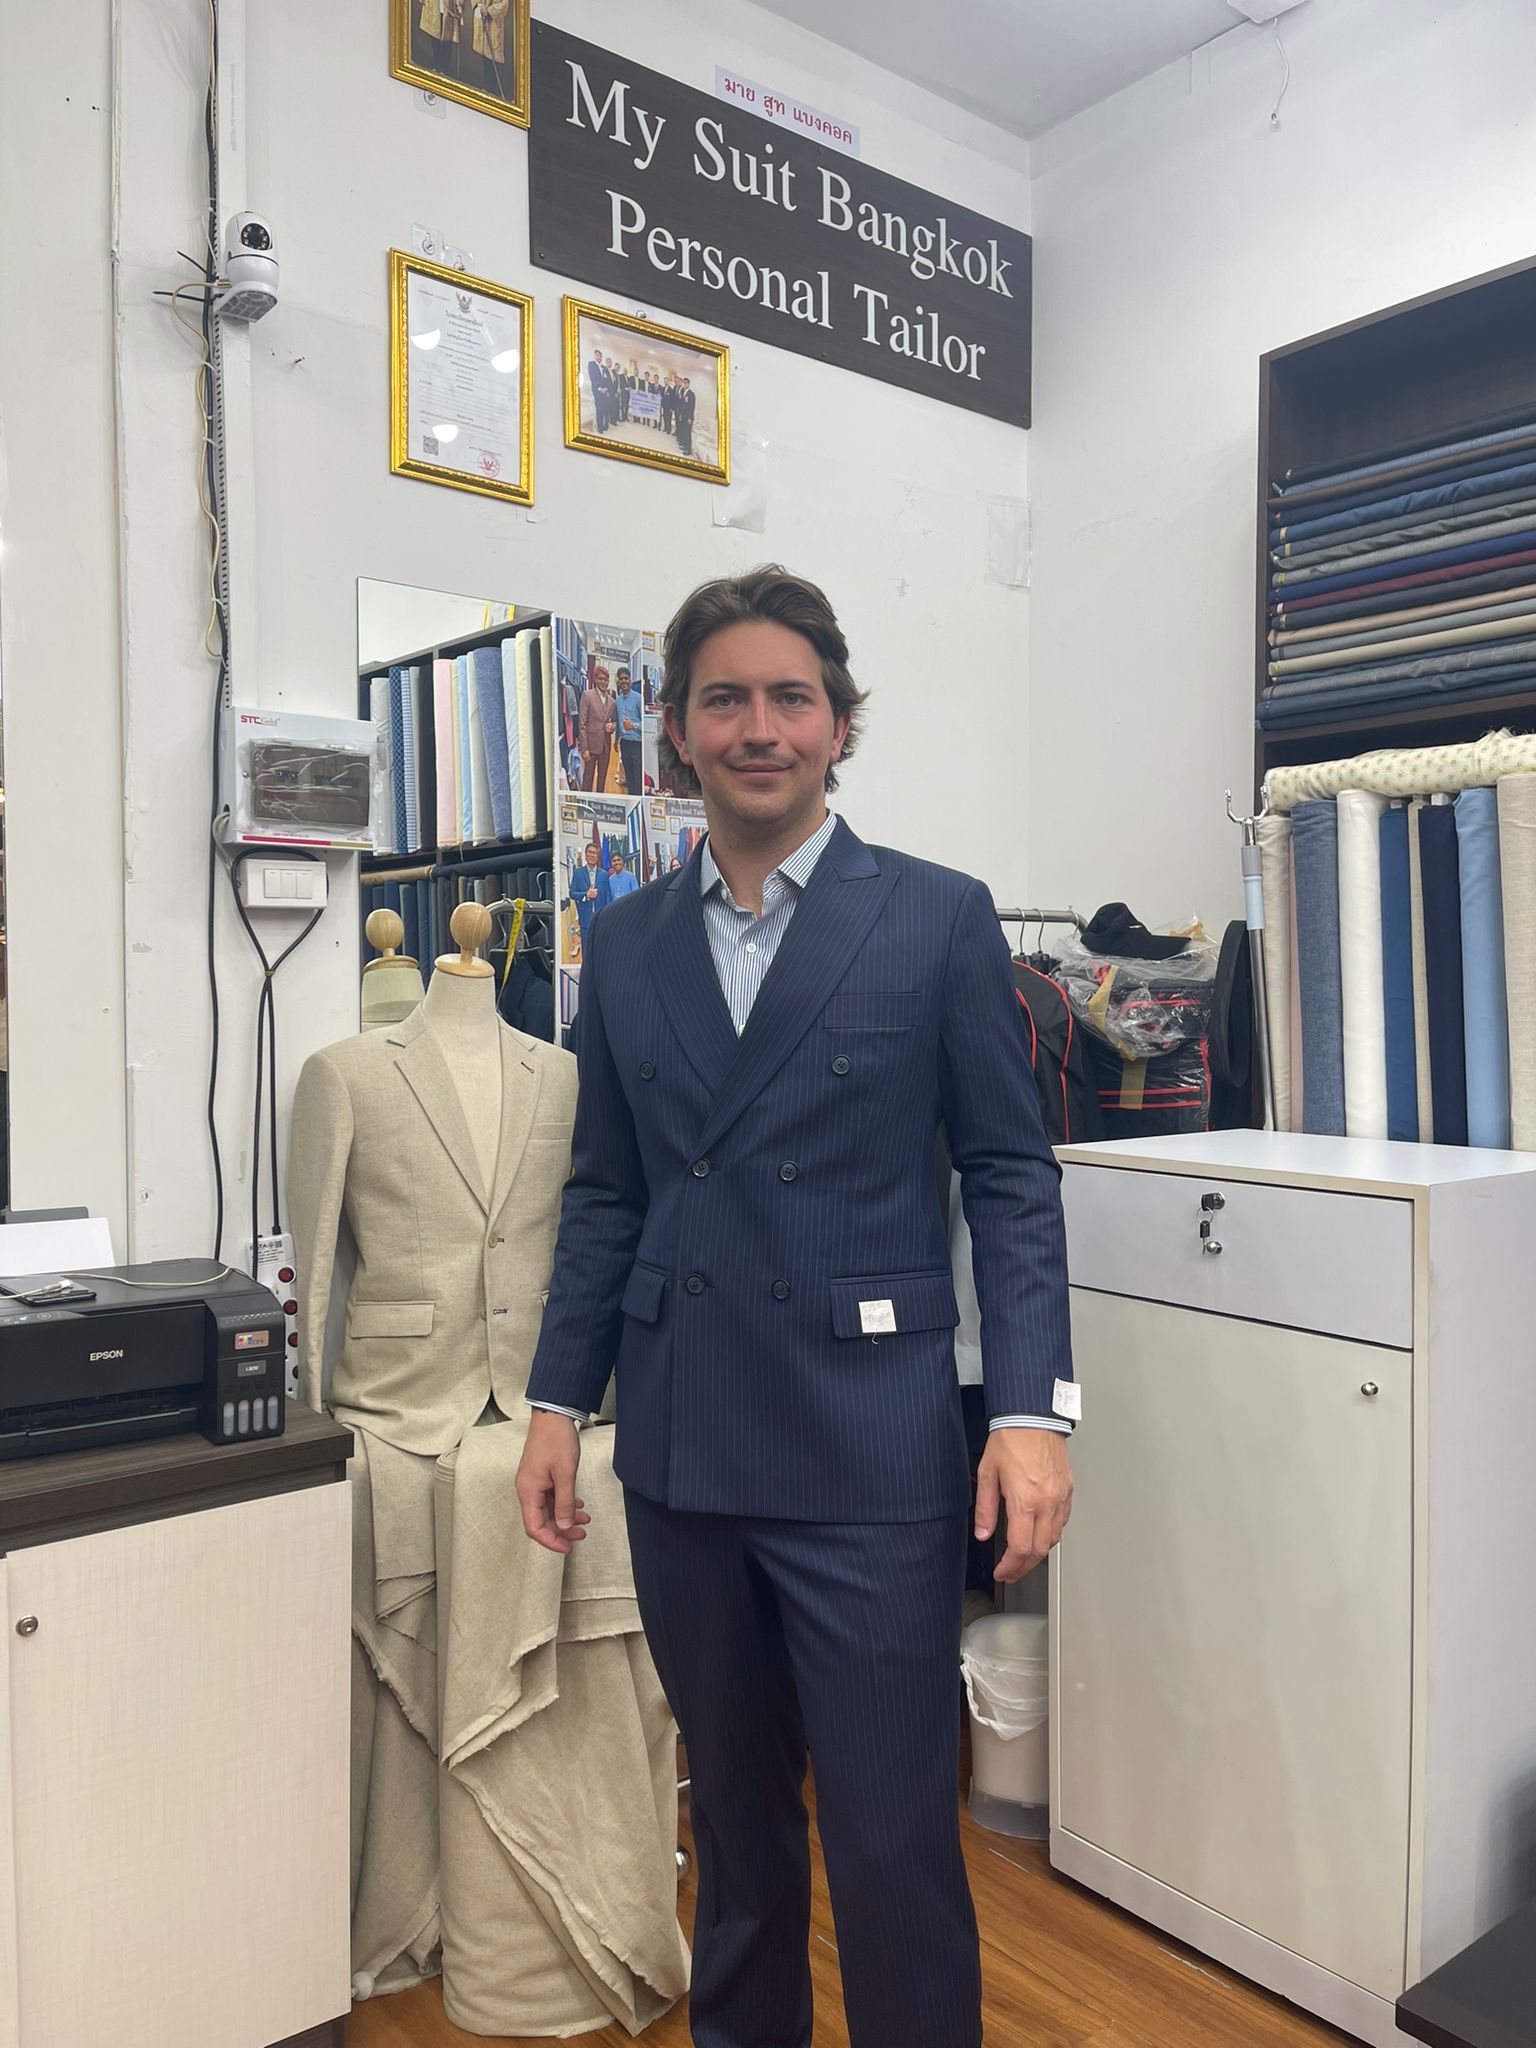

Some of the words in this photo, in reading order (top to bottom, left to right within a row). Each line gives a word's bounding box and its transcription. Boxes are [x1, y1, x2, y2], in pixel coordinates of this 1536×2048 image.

[724, 78, 755, 102] มาย
[763, 95, 785, 117] สูท
[793, 107, 852, 144] แบงคอค
[565, 60, 667, 170] My
[693, 117, 797, 211] Suit
[816, 166, 1014, 299] Bangkok
[605, 190, 834, 330] Personal
[853, 284, 986, 380] Tailor
[240, 715, 261, 725] STC
[90, 1350, 123, 1361] EPSON
